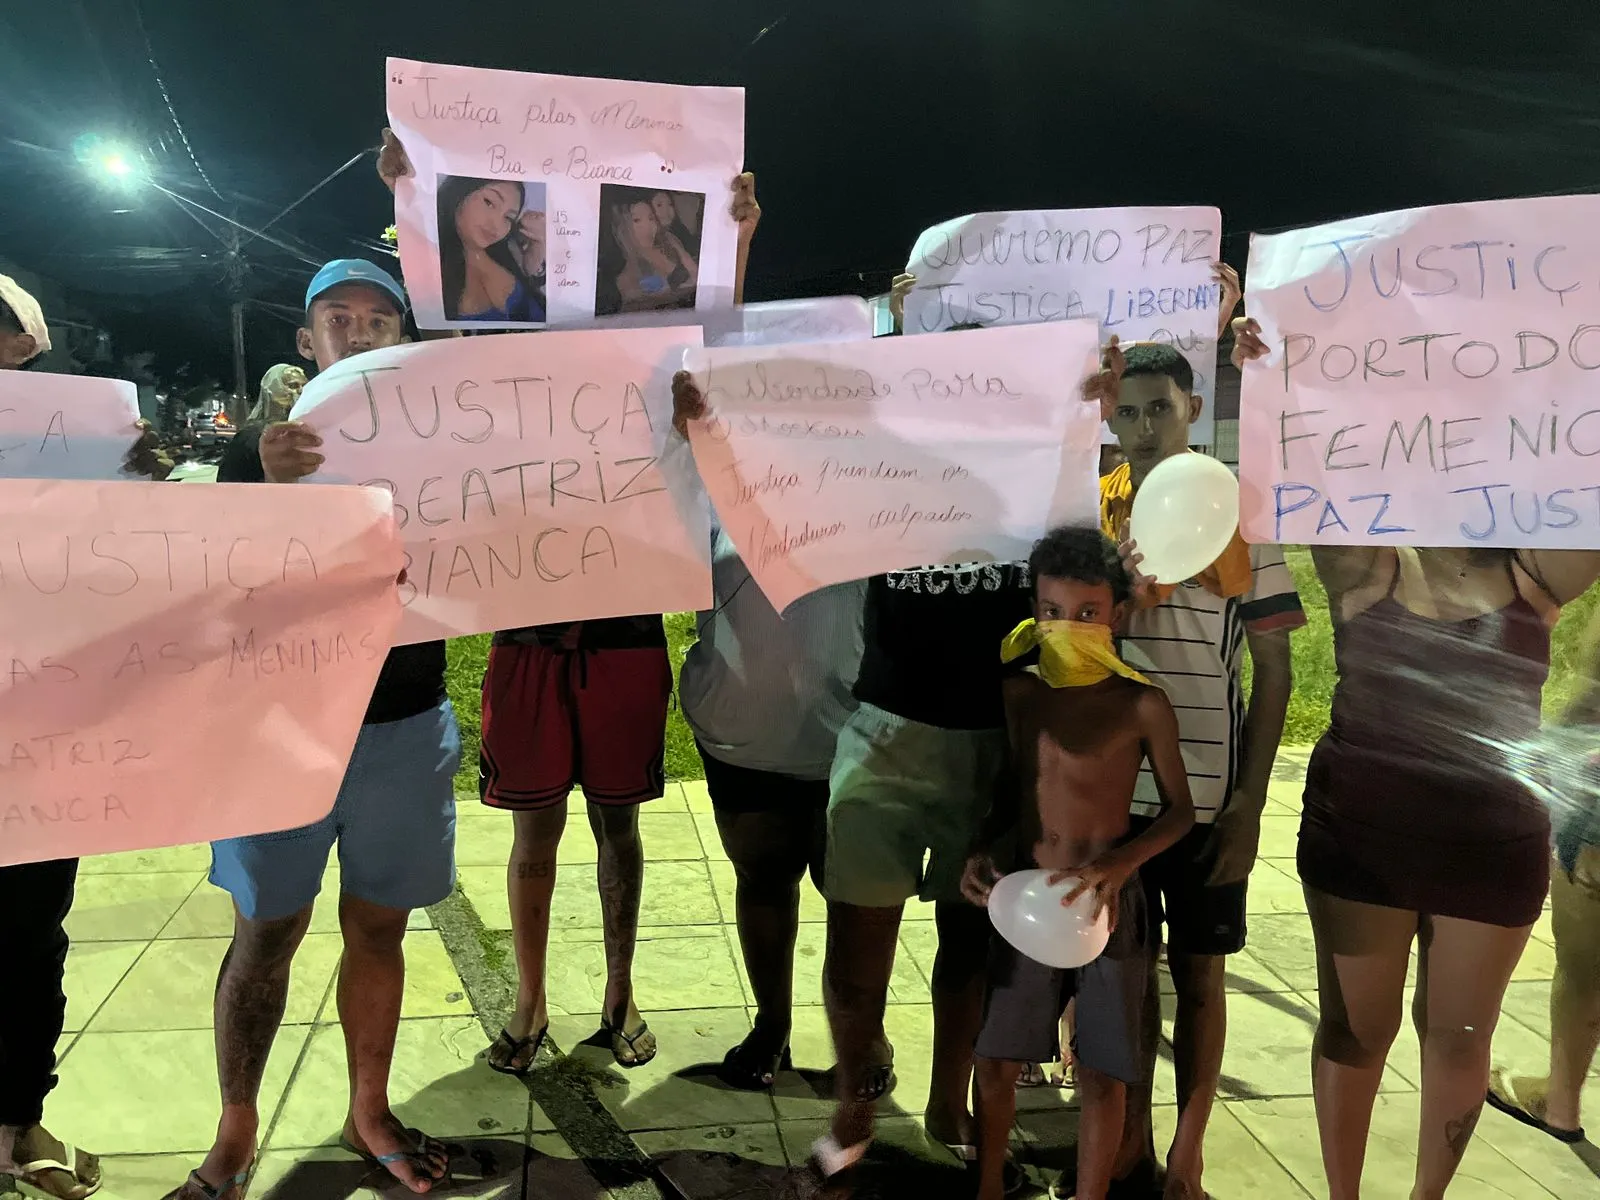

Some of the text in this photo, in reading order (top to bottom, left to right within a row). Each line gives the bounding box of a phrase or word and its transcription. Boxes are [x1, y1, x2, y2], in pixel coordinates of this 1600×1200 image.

[487, 143, 527, 174] Bia
[566, 145, 633, 180] Bianca
[1136, 223, 1214, 267] PAZ
[1300, 232, 1600, 312] JUSTiÇ
[330, 366, 654, 447] JUSTiÇA
[1272, 481, 1416, 541] PAZ
[0, 530, 318, 601] USTiÇA
[0, 655, 79, 687] AS
[0, 731, 151, 771] ATRIZ
